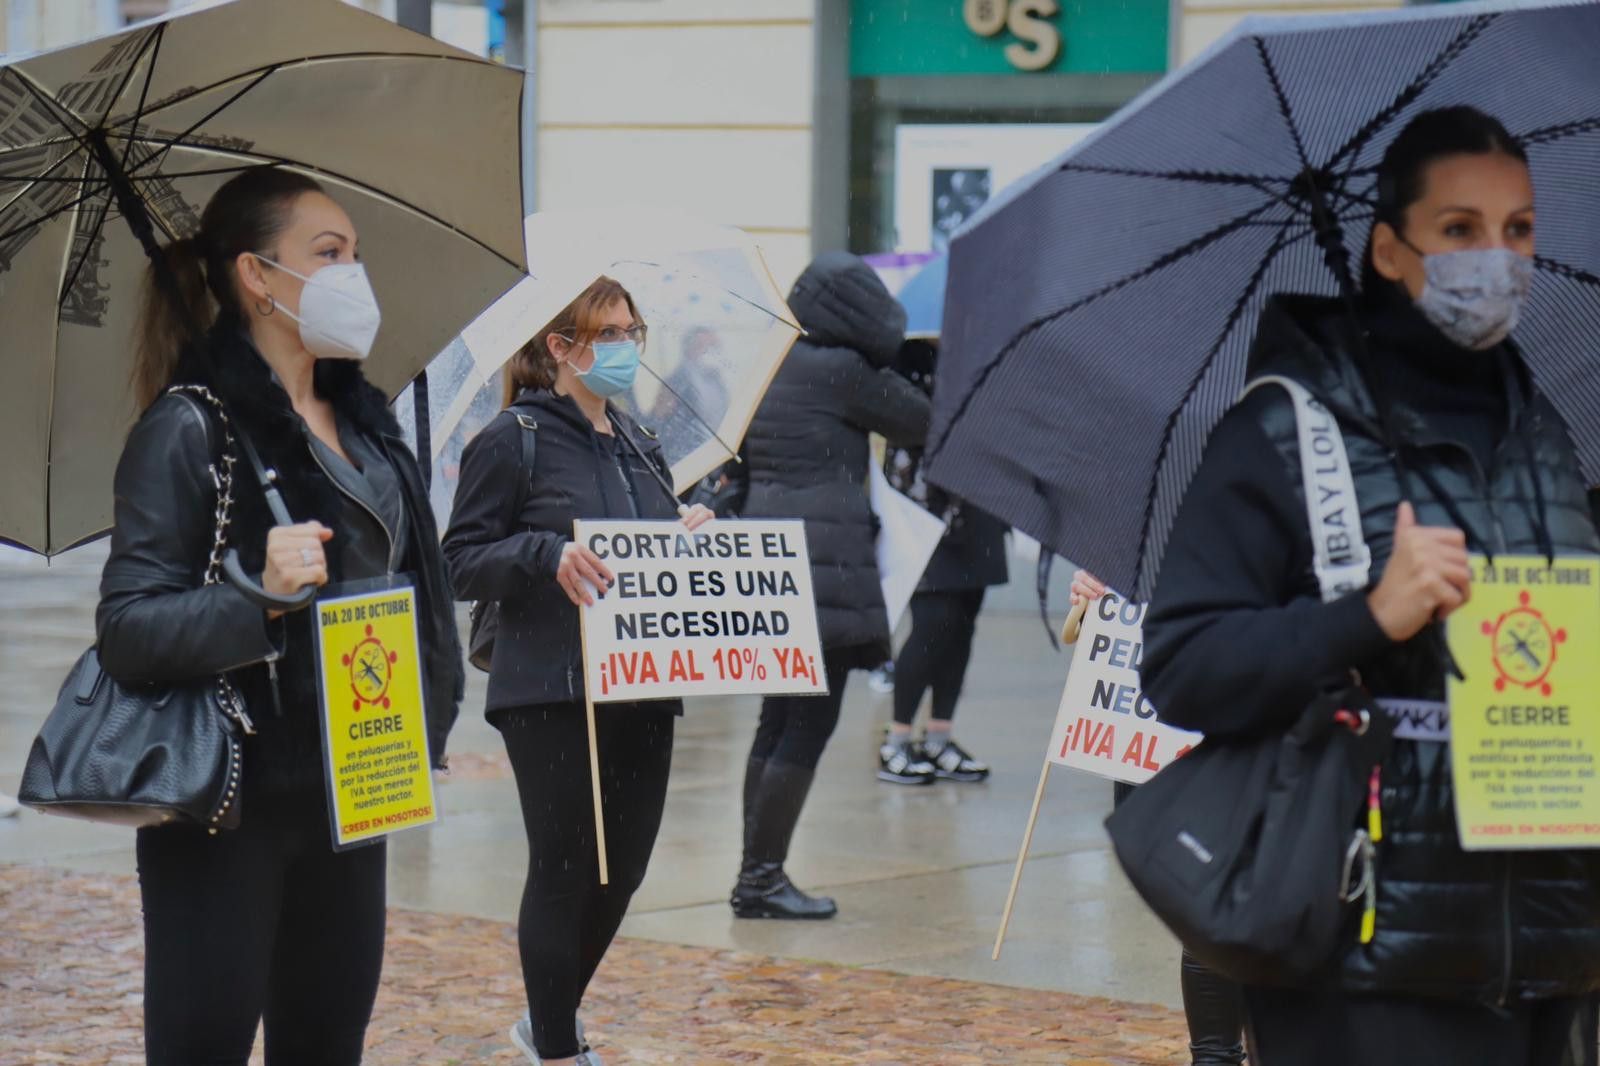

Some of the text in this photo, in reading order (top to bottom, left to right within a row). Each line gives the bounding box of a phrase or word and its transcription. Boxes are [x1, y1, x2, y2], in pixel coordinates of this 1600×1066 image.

[588, 532, 797, 560] CORTARSE EL
[688, 570, 726, 597] ES
[735, 569, 800, 597] UNA
[341, 608, 352, 623] 20
[355, 606, 366, 620] DE
[368, 598, 410, 619] OCTUBRE
[614, 610, 790, 640] NECESIDAD
[600, 650, 660, 696] ¡IVA
[668, 649, 705, 682] AL
[712, 647, 767, 681] 10%
[348, 714, 404, 741] CIERRE
[1484, 705, 1570, 727] CIERRE
[346, 751, 356, 761] en
[406, 740, 412, 750] y
[1060, 717, 1161, 772] ¡IVA AL
[374, 758, 384, 767] en
[385, 750, 419, 767] protesta
[341, 776, 355, 788] por
[356, 774, 364, 783] la
[407, 761, 420, 772] del
[349, 777, 414, 798] IVA que merece
[353, 797, 385, 810] nuestro
[372, 817, 383, 828] EN
